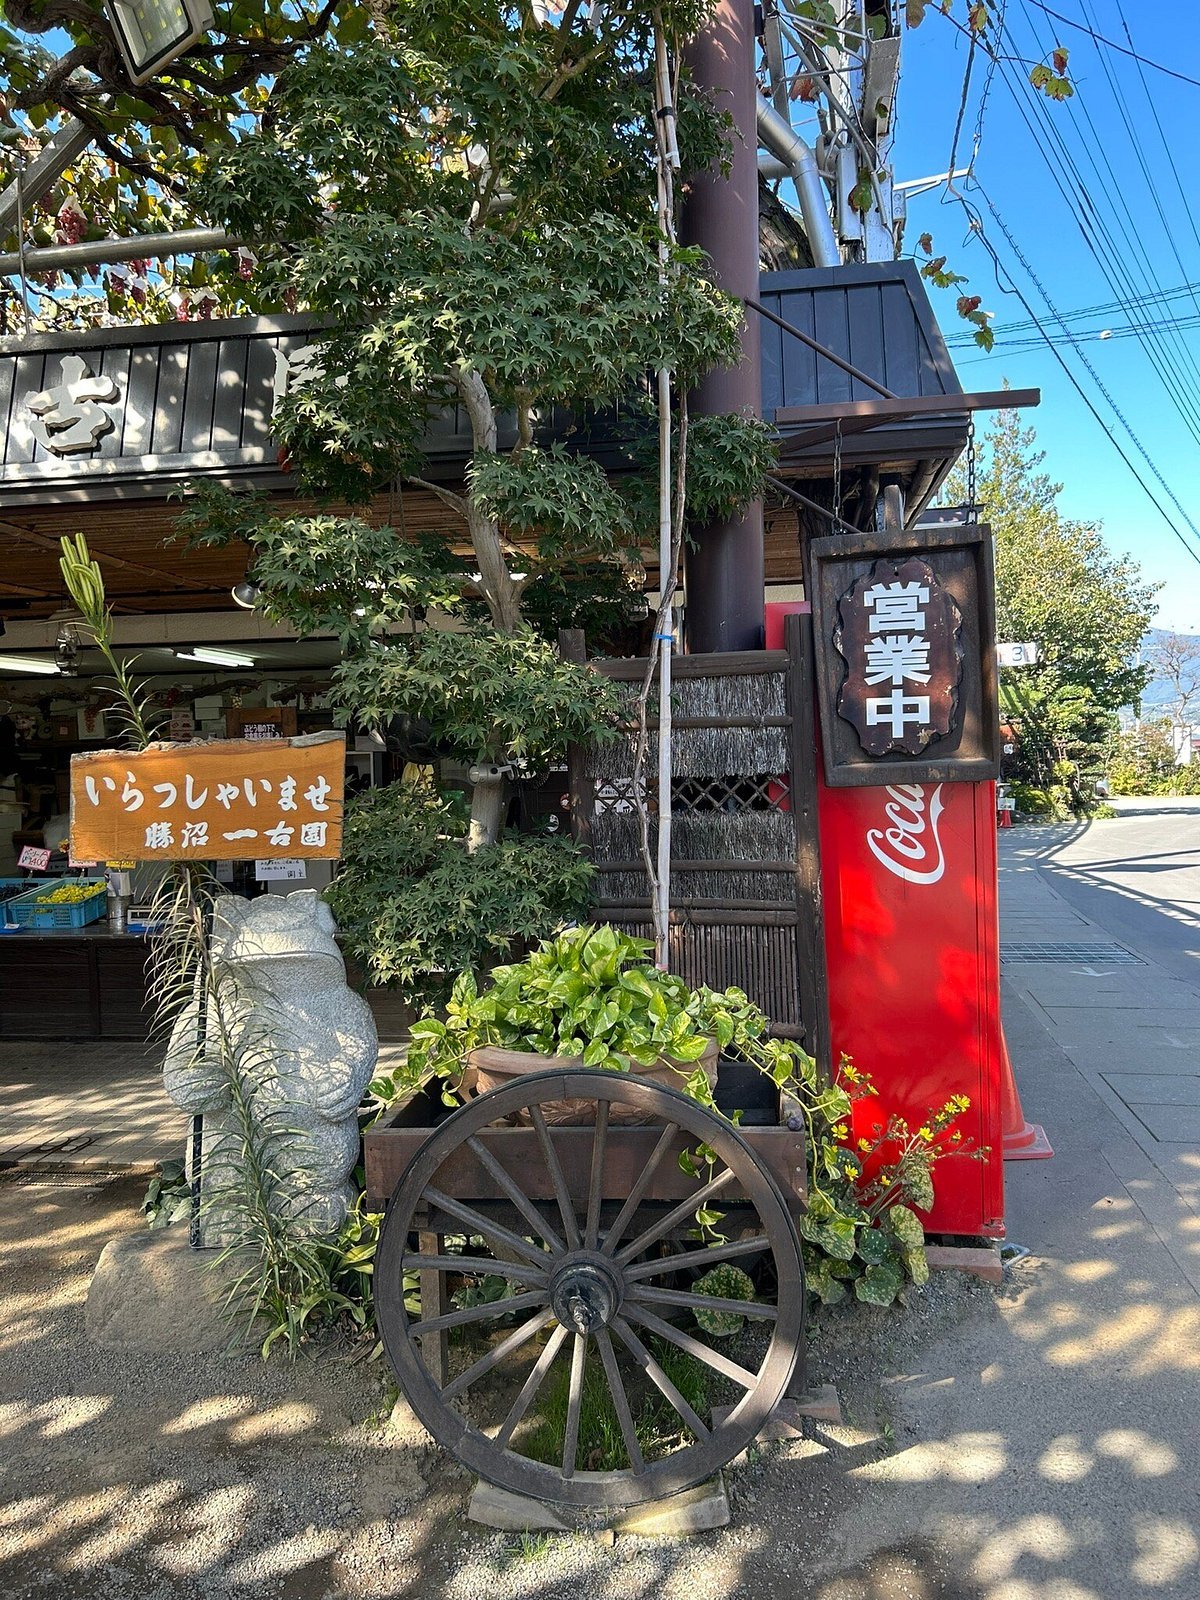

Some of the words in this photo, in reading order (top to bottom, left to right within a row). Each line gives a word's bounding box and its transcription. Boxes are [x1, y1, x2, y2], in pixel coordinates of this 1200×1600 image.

[863, 581, 932, 739] 営業中
[85, 770, 332, 812] いらっしゃいませ
